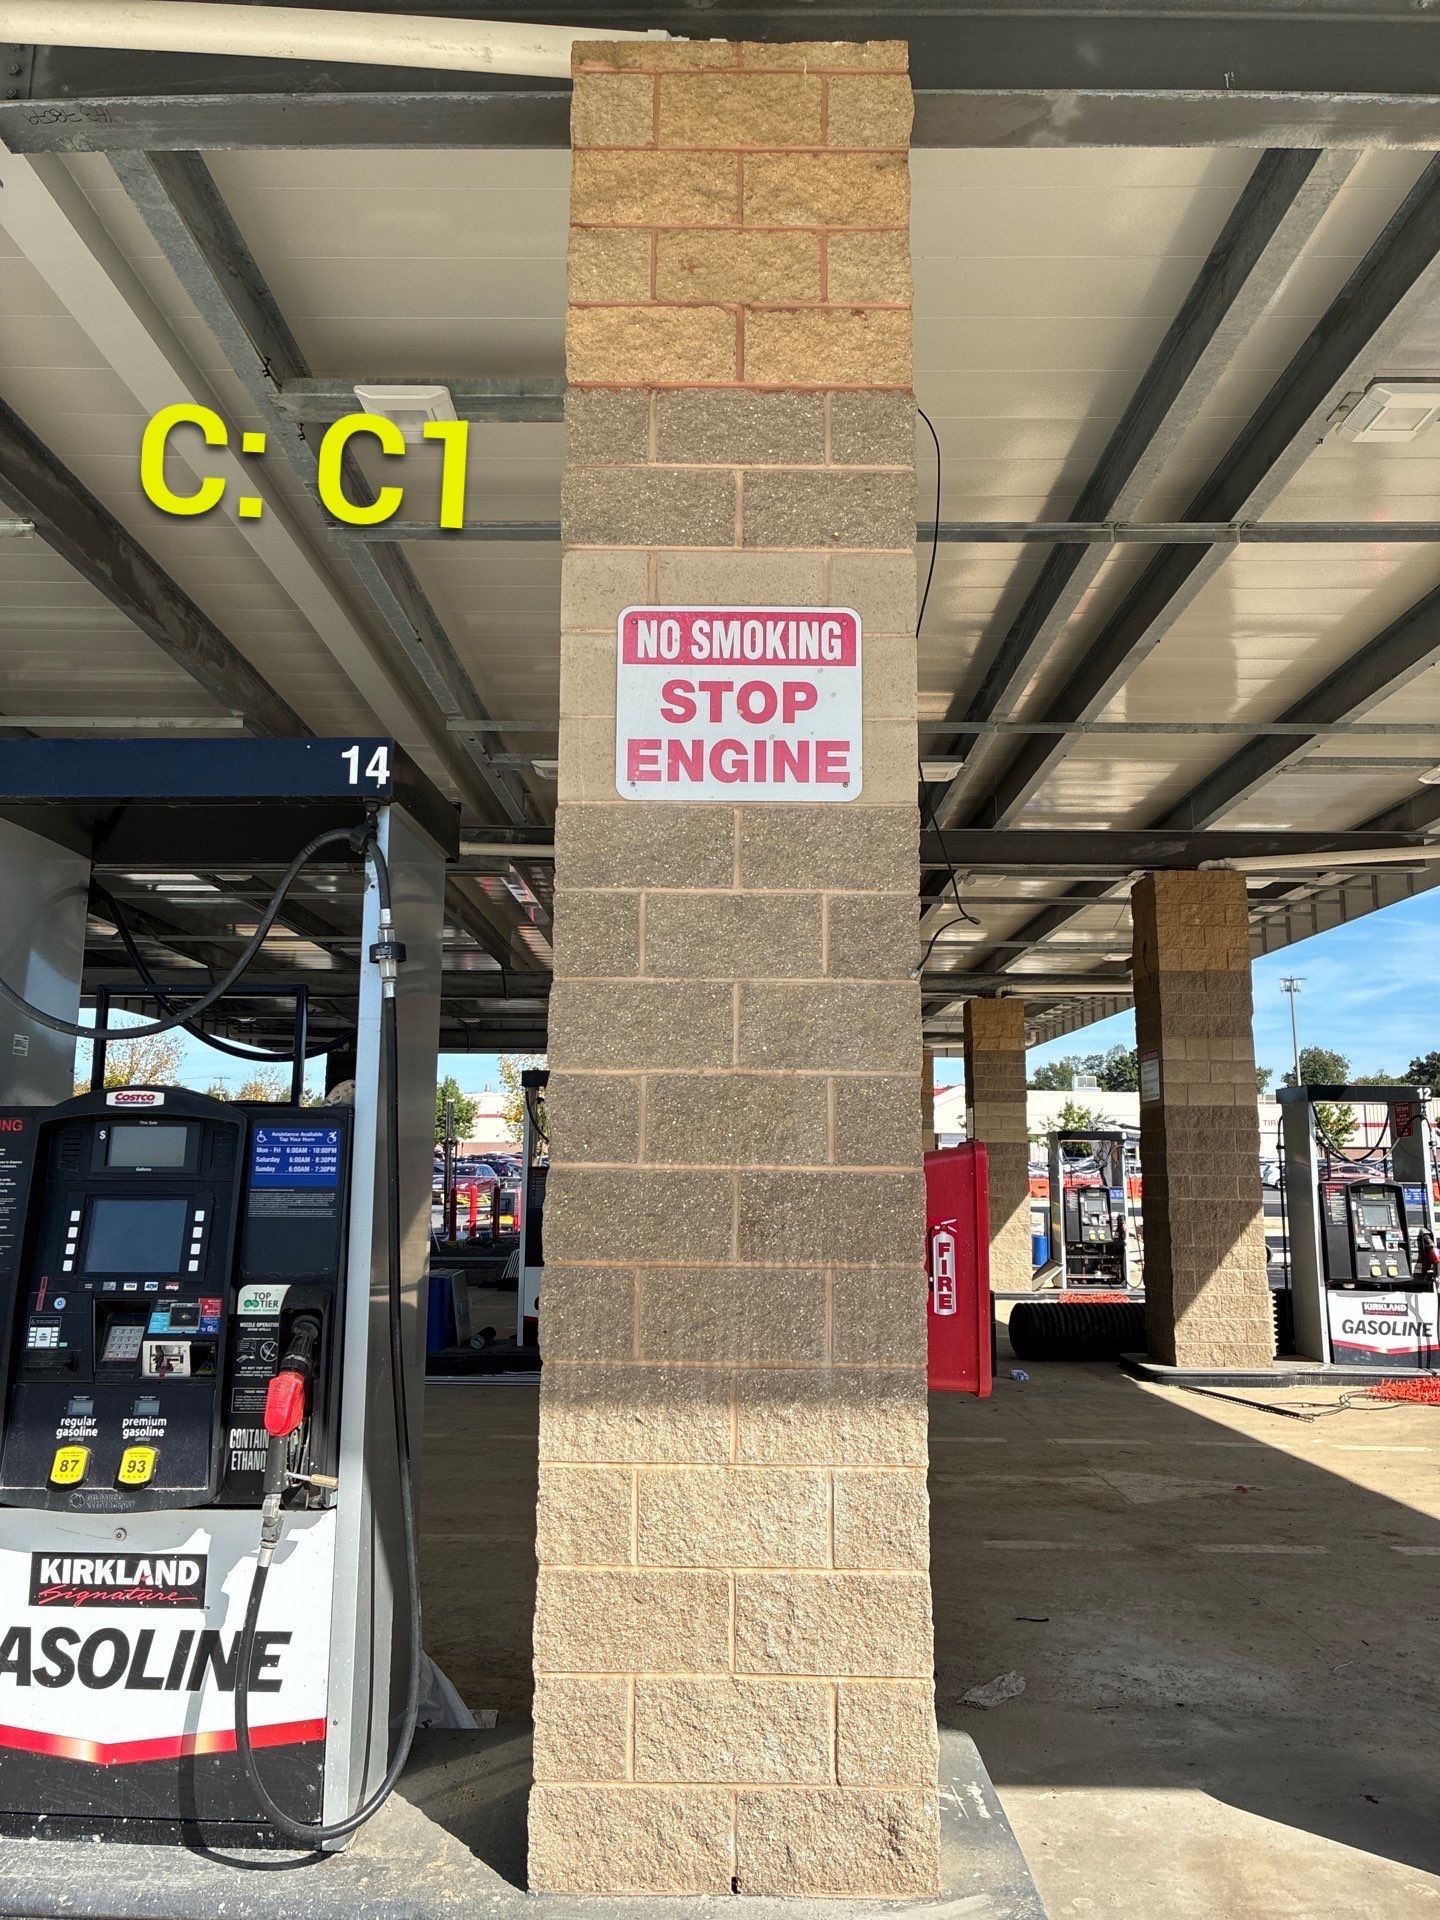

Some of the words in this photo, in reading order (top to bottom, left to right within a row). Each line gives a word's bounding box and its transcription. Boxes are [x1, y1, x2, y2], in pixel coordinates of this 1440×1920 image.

[637, 619, 681, 659] NO
[690, 619, 842, 661] SMOKING
[660, 678, 818, 725] STOP
[341, 745, 391, 785] 14
[626, 738, 851, 784] ENGINE
[114, 1093, 156, 1101] COSTCO
[1416, 1087, 1432, 1100] 12
[99, 1129, 107, 1141] $
[255, 1156, 281, 1164] Saturday
[937, 1242, 953, 1310] FIRE
[253, 1292, 272, 1300] TOP
[260, 1300, 279, 1308] TIER
[1363, 1302, 1407, 1312] KIRKLAND
[1341, 1318, 1434, 1338] GASOLINE
[60, 1416, 98, 1428] regular
[121, 1416, 168, 1429] premium
[56, 1426, 99, 1440] gasoline
[122, 1426, 166, 1440] gasoline
[229, 1428, 269, 1449] CONTAIN
[59, 1459, 80, 1473] 87
[126, 1459, 147, 1474] 93
[231, 1450, 266, 1471] ETHANO
[39, 1558, 200, 1587] KIRKLAND
[38, 1583, 199, 1608] Signature
[0, 1625, 293, 1694] ASOLINE
